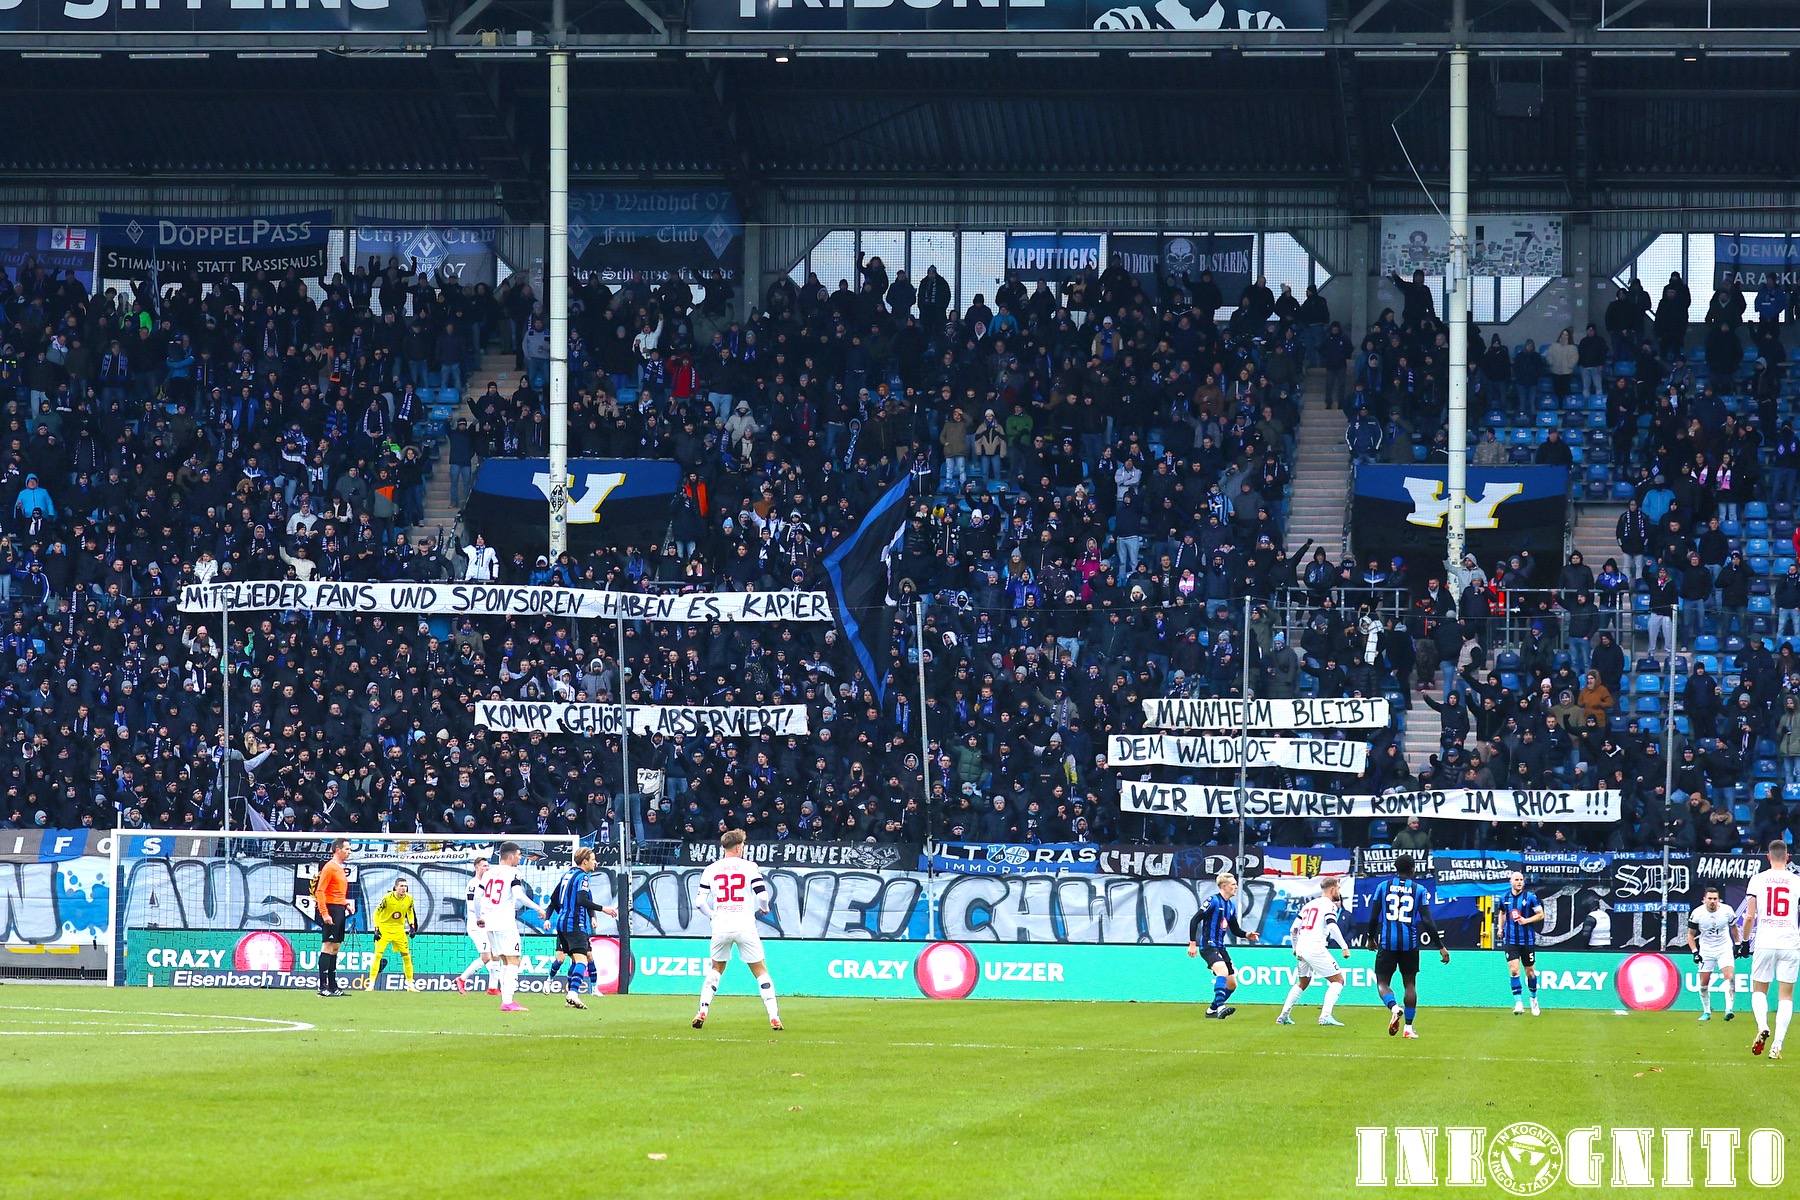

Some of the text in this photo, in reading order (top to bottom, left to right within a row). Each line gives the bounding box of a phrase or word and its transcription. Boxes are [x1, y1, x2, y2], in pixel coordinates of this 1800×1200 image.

[613, 191, 698, 214] Waldhof
[197, 260, 236, 272] STATT
[242, 249, 324, 272] RASSISMUS!
[1007, 248, 1098, 270] KAPUTTICKS
[316, 584, 378, 610] FANS
[391, 585, 438, 609] UND
[452, 586, 584, 614] SPONSOREN
[603, 592, 676, 618] HABEN
[687, 597, 721, 620] ES
[742, 594, 831, 619] KAPIER
[483, 705, 551, 730] KOMPP
[1155, 698, 1383, 727] MANNHEIM BLEIBT
[1116, 734, 1356, 767] DEM WALDHOF TREU
[1131, 784, 1609, 817] WIR VERSENKEN KOMPP IM RHOI !!!
[689, 843, 853, 863] WAHOF-POWER
[1451, 859, 1482, 869] GEGEN
[1697, 856, 1761, 879] BARACKLER
[484, 879, 506, 905] 43
[714, 873, 746, 903] 32
[1386, 893, 1414, 923] 32
[1766, 887, 1790, 917] 16
[146, 949, 226, 968] CRAZY
[299, 950, 375, 970] UZER
[827, 959, 910, 979] CRAZY
[984, 961, 1065, 982] UZZER
[173, 970, 272, 987] Eisenbach
